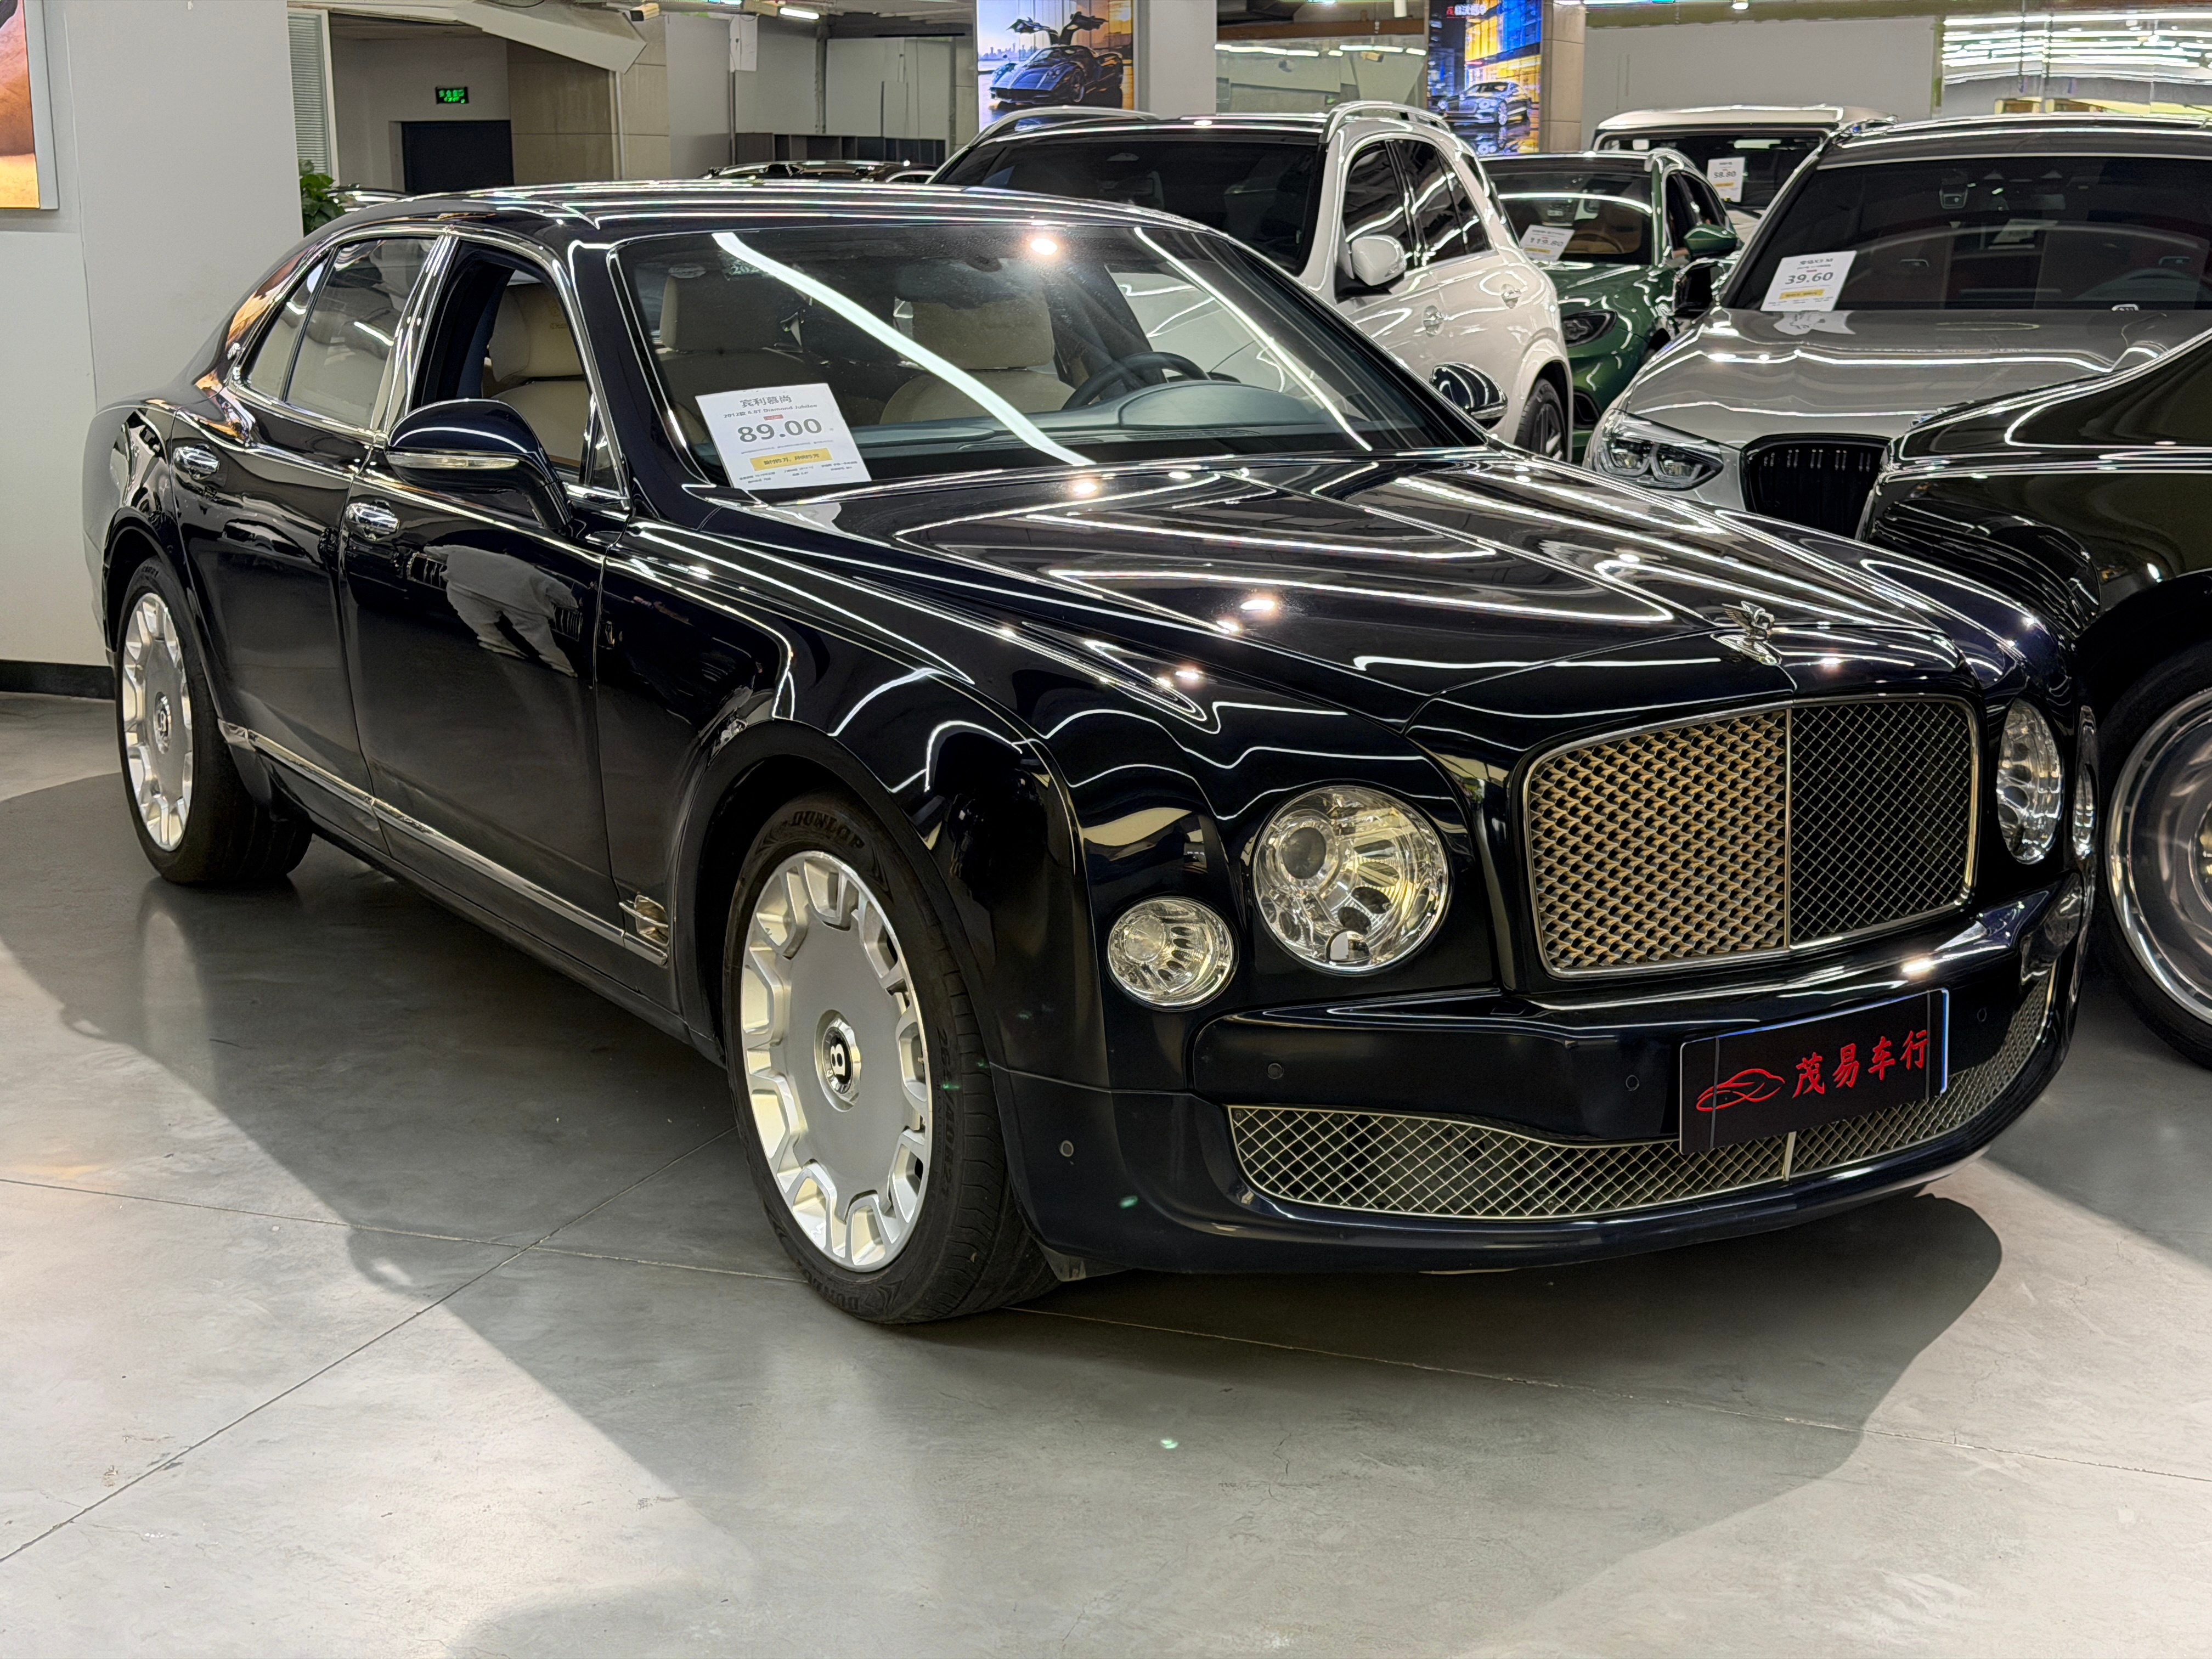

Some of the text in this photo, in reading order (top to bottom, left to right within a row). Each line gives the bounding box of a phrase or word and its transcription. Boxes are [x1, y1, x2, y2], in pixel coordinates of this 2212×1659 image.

[1785, 272, 1833, 284] 39.60
[739, 394, 792, 408] 宾利慕尚
[737, 418, 822, 443] 89.00
[793, 810, 865, 849] DUNLOP
[1792, 1029, 1928, 1099] 茂易车行
